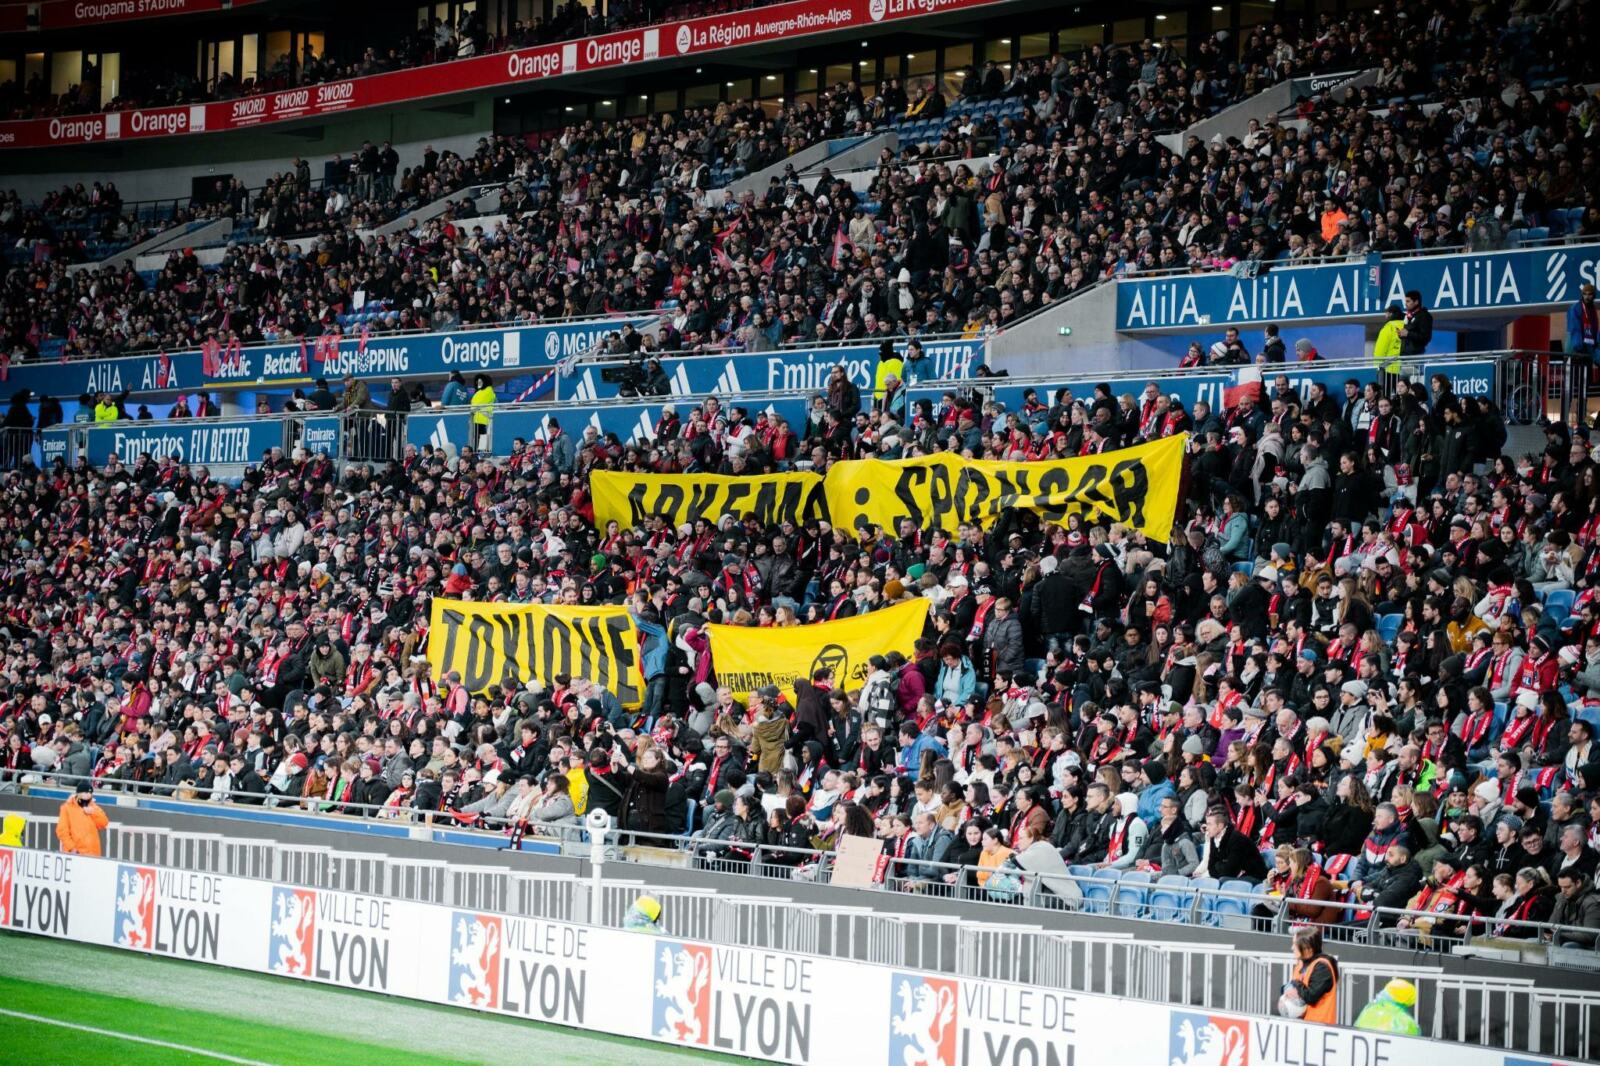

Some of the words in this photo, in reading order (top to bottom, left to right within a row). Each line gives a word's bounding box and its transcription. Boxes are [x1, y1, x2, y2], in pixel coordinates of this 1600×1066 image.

[75, 2, 134, 19] Groupama
[693, 28, 707, 46] La
[710, 22, 751, 44] Région
[754, 8, 852, 36] Auvergne-Rhône-Alpes
[508, 52, 560, 77] Orange
[586, 38, 641, 64] Orange
[232, 98, 266, 117] SWORD
[273, 90, 309, 110] SWORD
[317, 82, 353, 103] SWORD
[49, 118, 103, 141] Orange
[131, 111, 187, 133] Orange
[1326, 268, 1407, 314] AlA
[441, 336, 500, 367] Orange
[563, 332, 586, 355] MG
[141, 359, 178, 390] AlA
[263, 350, 302, 375] Betclic
[1450, 376, 1489, 395] irates
[114, 430, 184, 465] Emirates
[190, 428, 209, 463] FLY
[210, 427, 250, 462] BETTER
[15, 851, 50, 879] VILLE
[54, 856, 72, 884] DE
[158, 870, 198, 901] VILLE
[202, 876, 222, 905] DE
[12, 885, 71, 935] LYON
[319, 893, 363, 926] VILLE
[370, 900, 391, 930] DE
[154, 904, 220, 961] LYON
[505, 919, 555, 956] VILLE
[562, 926, 588, 960] DE
[315, 929, 389, 990] LYON
[717, 949, 775, 988] VILLE
[784, 956, 812, 994] DE
[502, 957, 586, 1024] LYON
[963, 981, 1033, 1027] VILLE
[1043, 993, 1077, 1033] DE
[714, 990, 811, 1062] LYON
[1256, 1021, 1337, 1066] VILLE
[1354, 1035, 1391, 1066] DE
